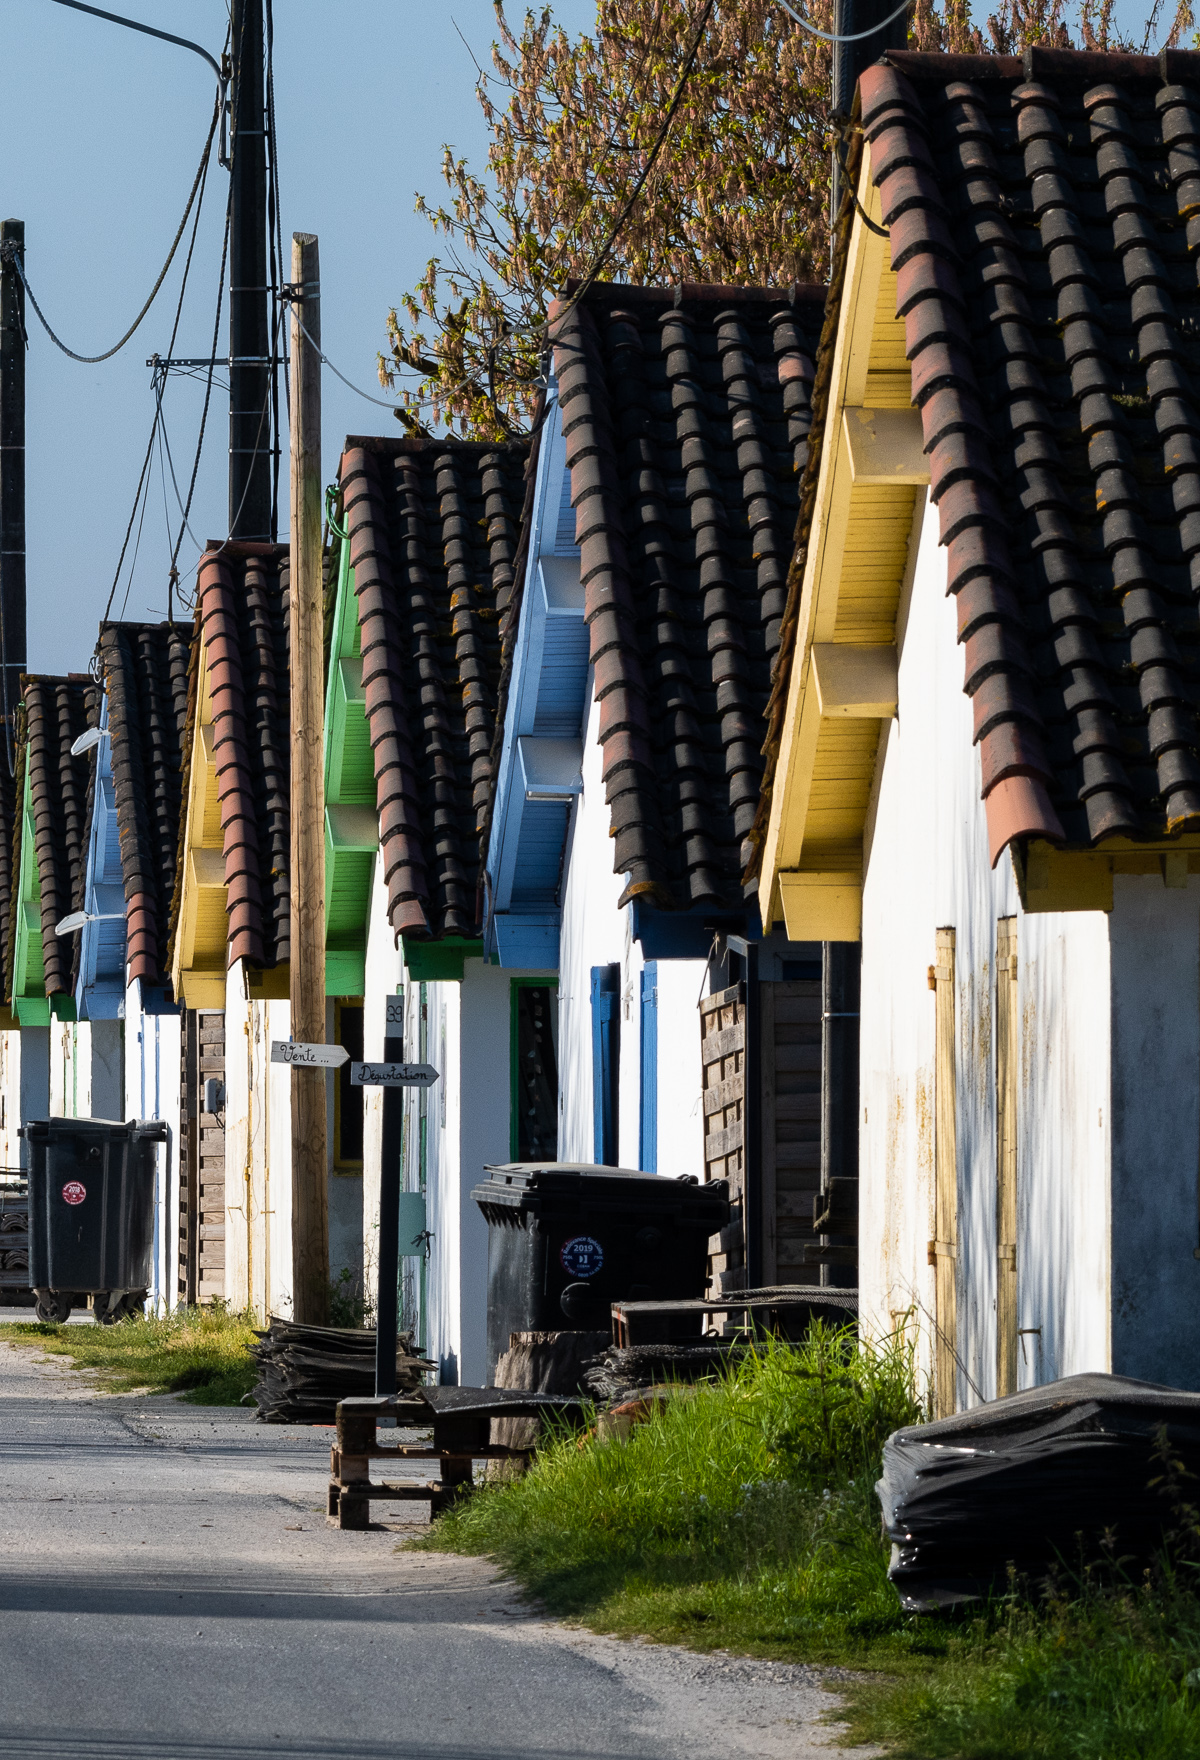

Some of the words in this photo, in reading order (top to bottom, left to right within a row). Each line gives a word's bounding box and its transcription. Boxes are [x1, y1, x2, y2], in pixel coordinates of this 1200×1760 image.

[386, 1005, 403, 1023] 39
[280, 1044, 317, 1063] Vente
[358, 1065, 428, 1085] Dégustation
